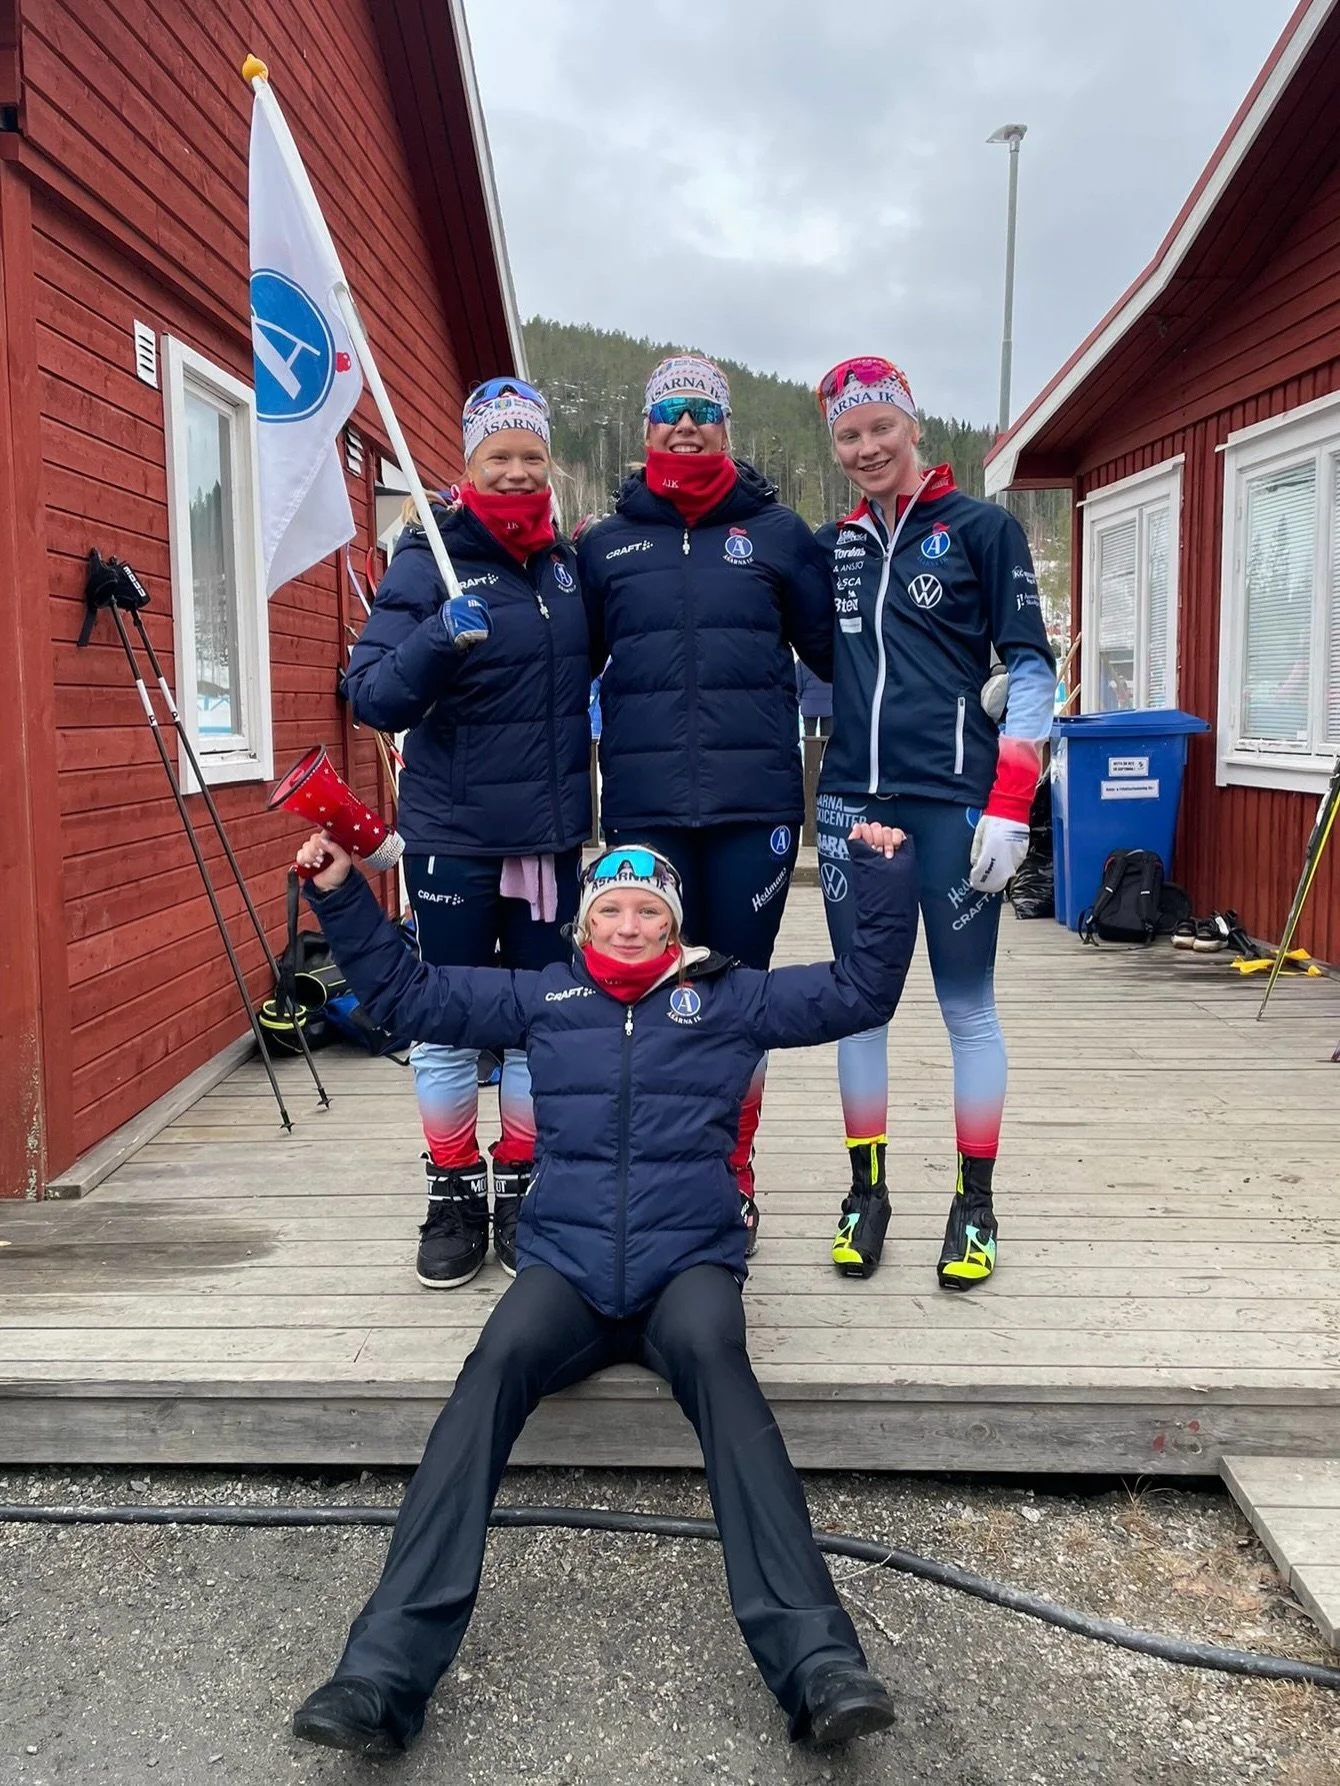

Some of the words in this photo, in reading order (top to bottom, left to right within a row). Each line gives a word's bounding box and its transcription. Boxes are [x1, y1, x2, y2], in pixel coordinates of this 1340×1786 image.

[651, 376, 705, 402] SARNA
[878, 391, 895, 403] IK
[606, 542, 642, 560] CRAFT
[816, 794, 843, 811] ARNA
[417, 889, 452, 904] CRAFT
[952, 893, 989, 930] CRAFT
[545, 986, 583, 1001] CRAFT
